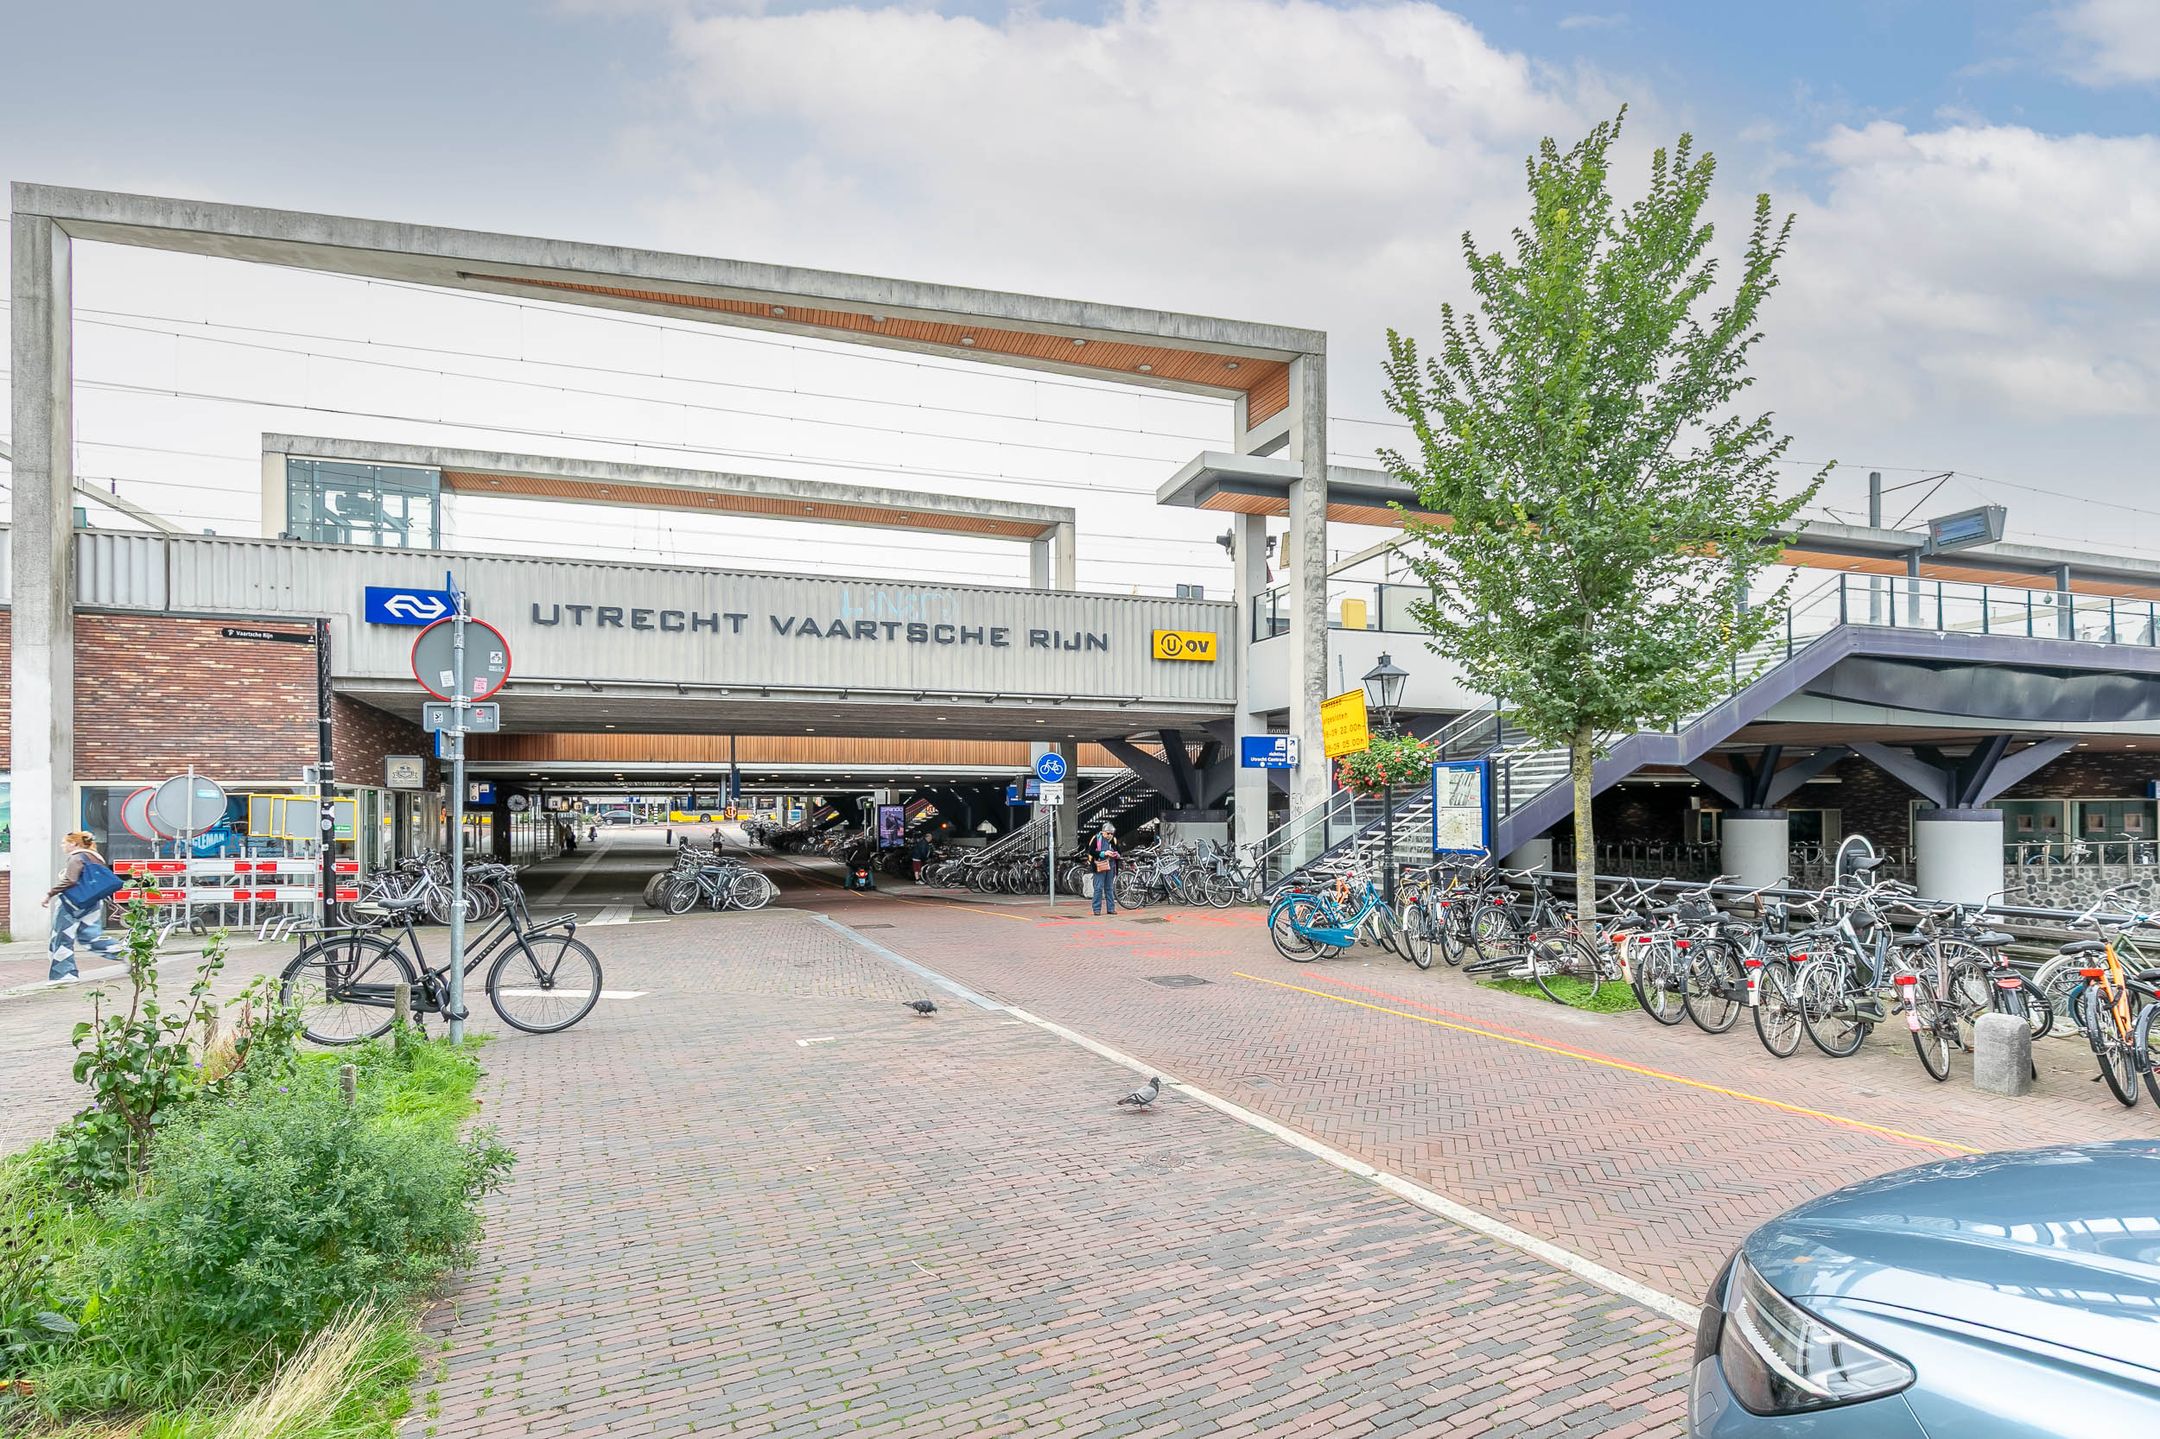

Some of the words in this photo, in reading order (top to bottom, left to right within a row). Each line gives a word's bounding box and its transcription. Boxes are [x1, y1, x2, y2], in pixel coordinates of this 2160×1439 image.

[236, 630, 261, 638] Vaartsche
[532, 603, 748, 634] UTRECHT
[770, 614, 1010, 647] VAARTSCHE
[1030, 628, 1109, 652] RIJN
